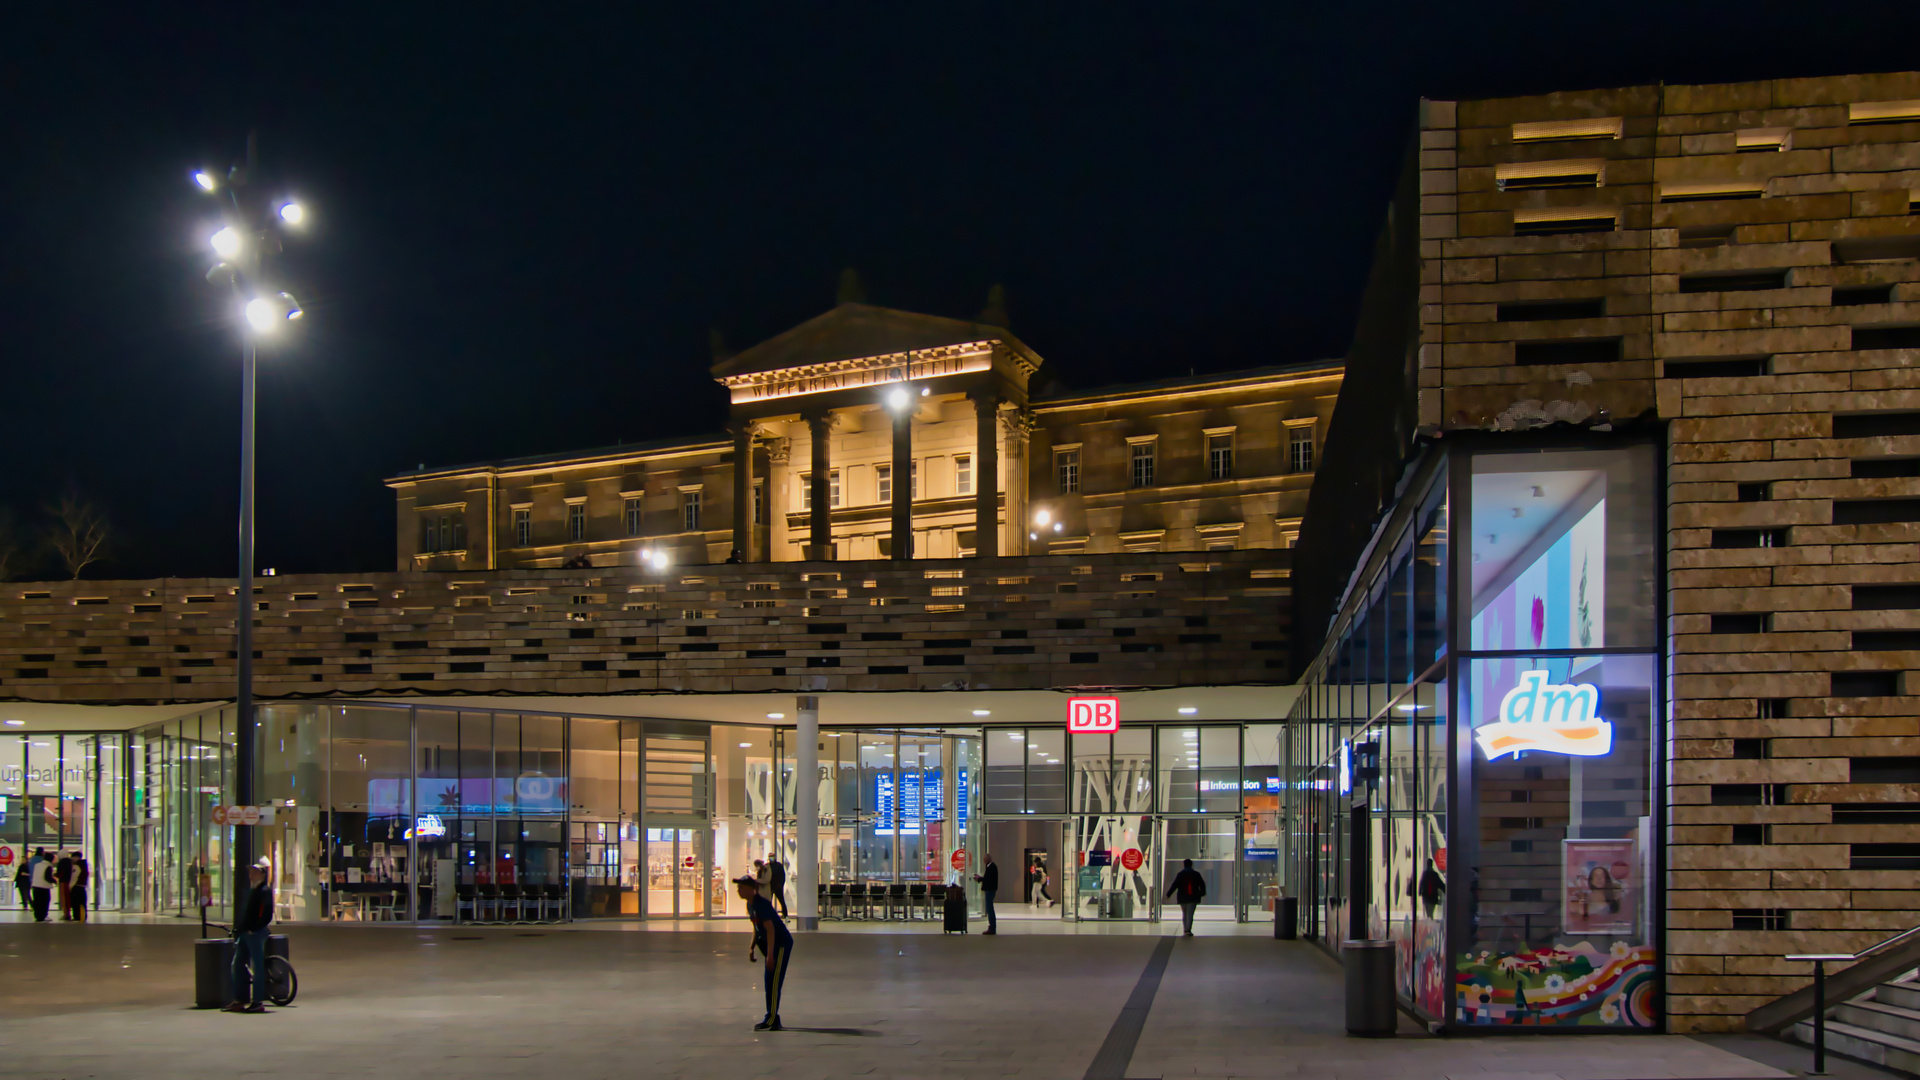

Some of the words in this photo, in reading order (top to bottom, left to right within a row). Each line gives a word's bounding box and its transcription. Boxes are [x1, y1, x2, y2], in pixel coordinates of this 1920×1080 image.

[1507, 676, 1590, 723] dm
[1075, 703, 1112, 727] DB
[1210, 780, 1260, 790] Informtion
